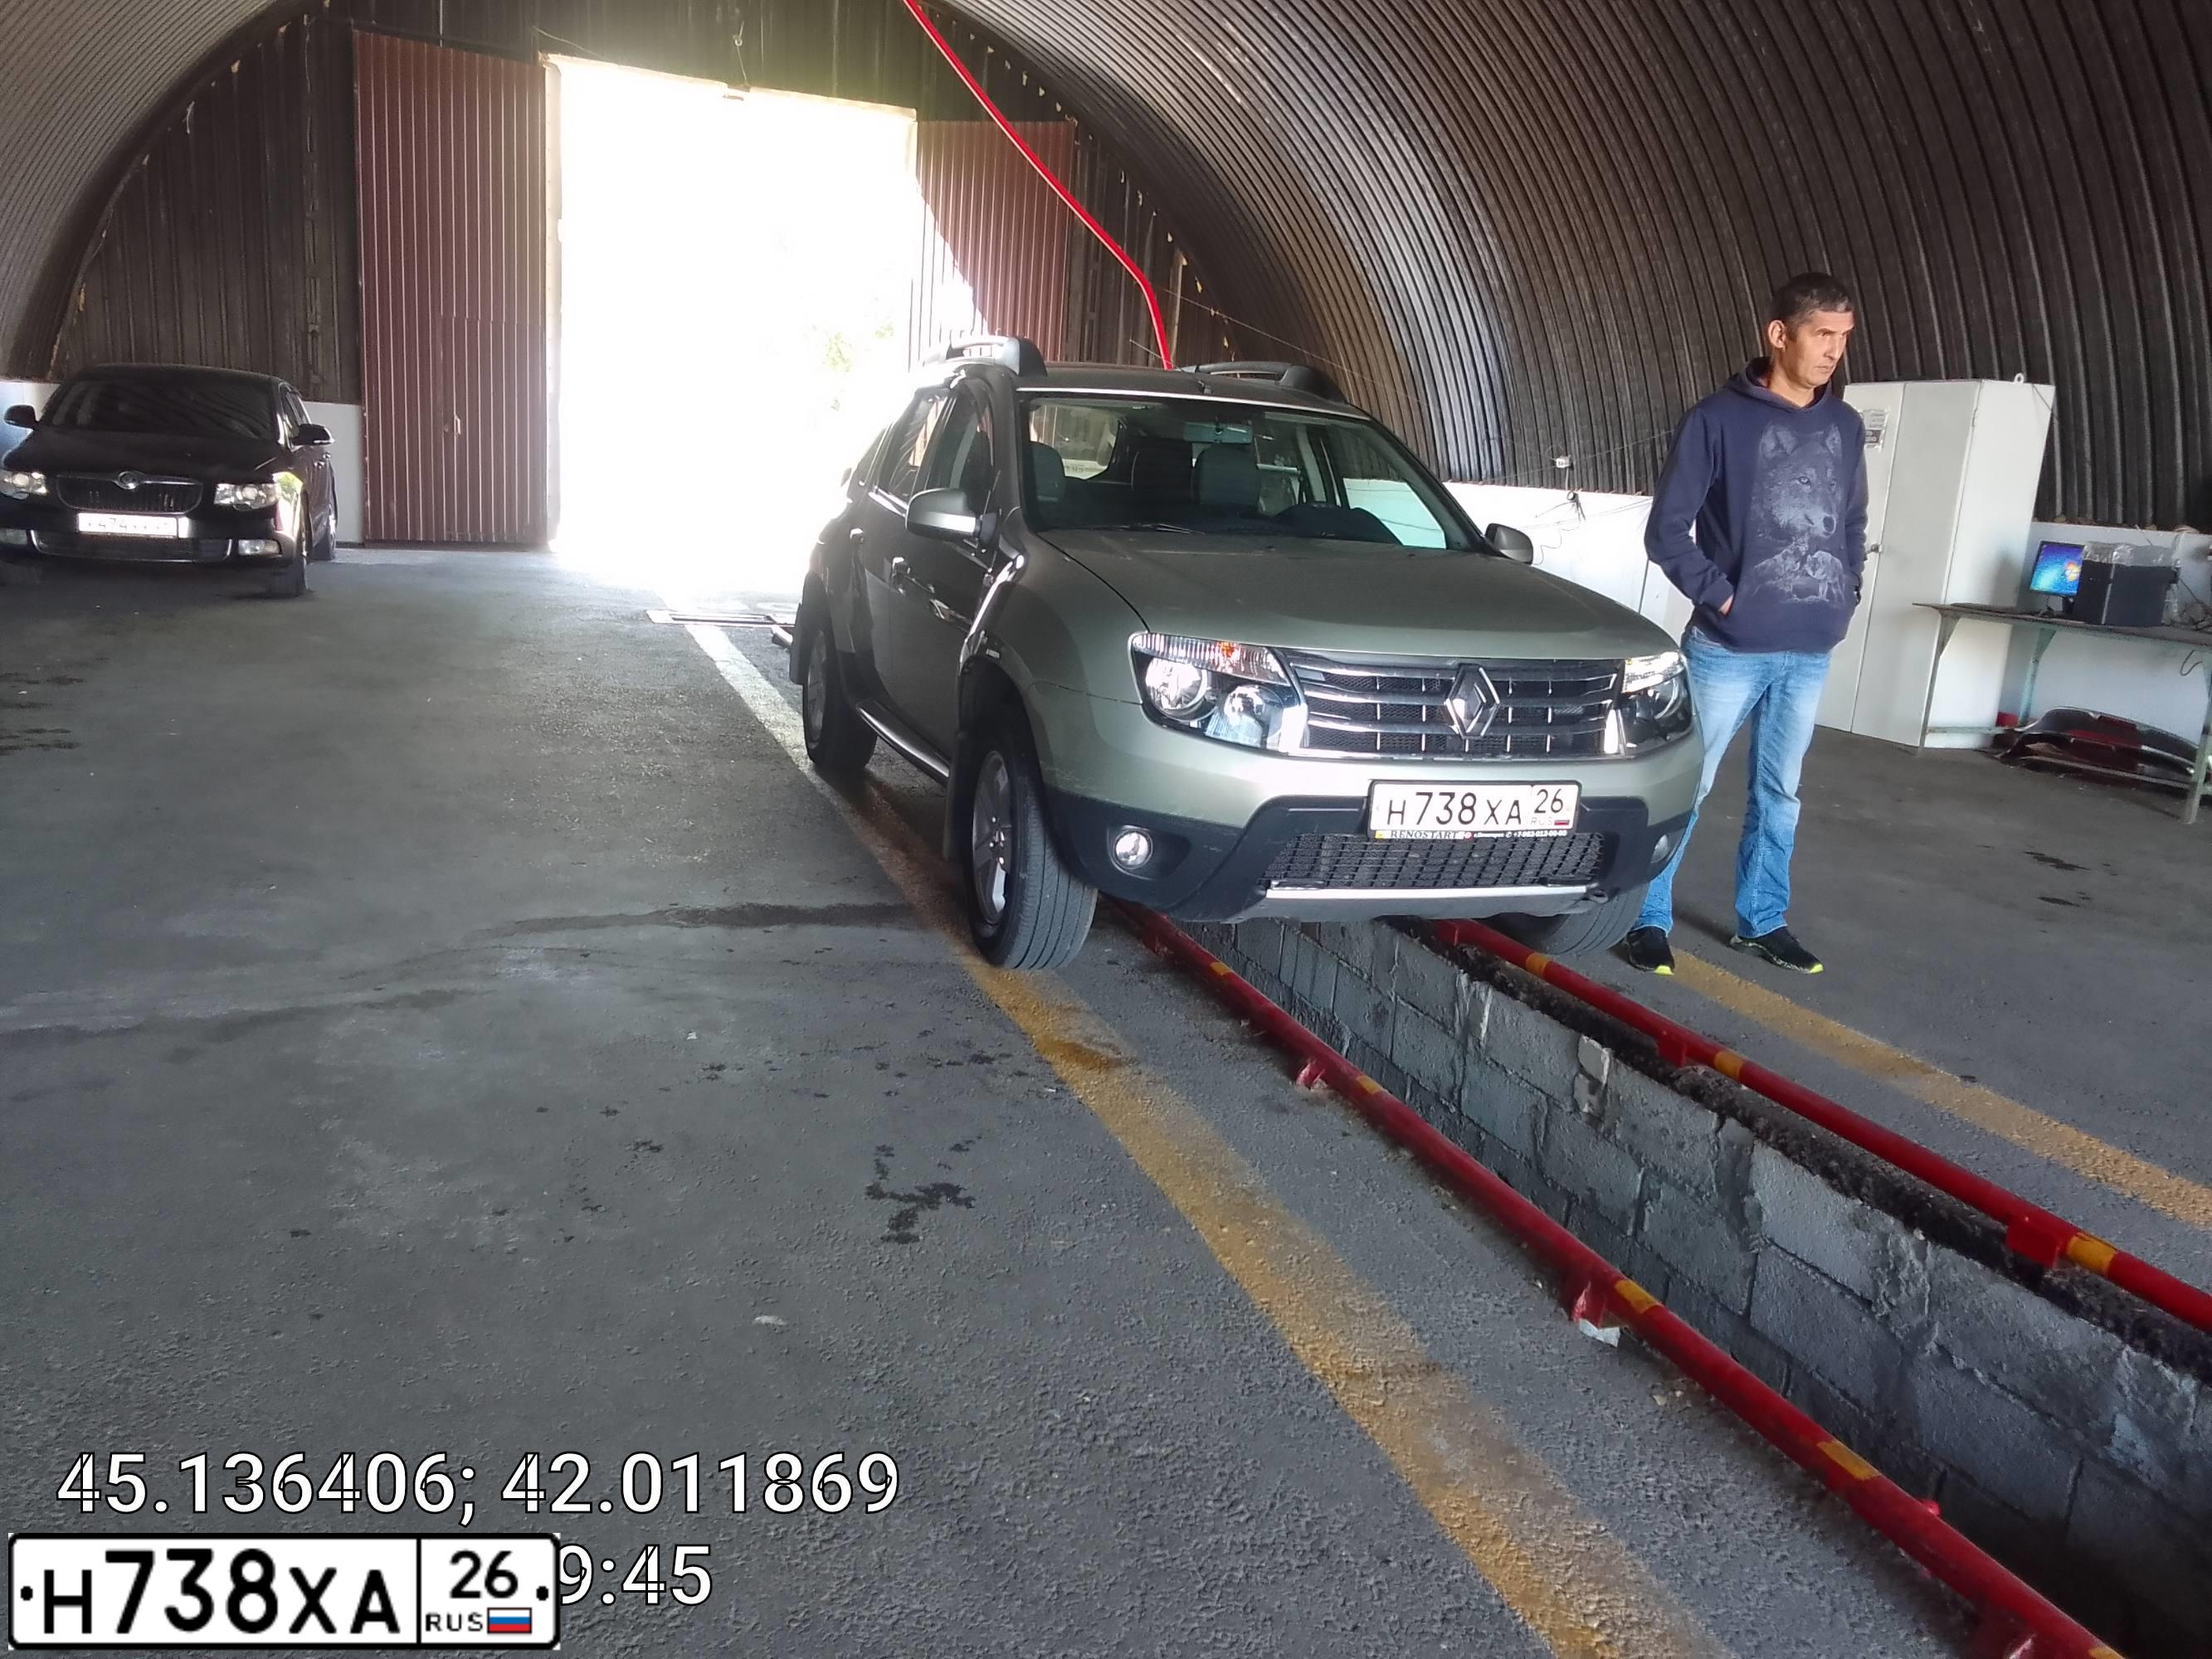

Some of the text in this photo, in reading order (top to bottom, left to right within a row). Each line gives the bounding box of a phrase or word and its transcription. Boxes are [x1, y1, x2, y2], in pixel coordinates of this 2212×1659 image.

[1386, 788, 1564, 825] Н738ХА 26
[1390, 830, 1459, 839] RENOSTART
